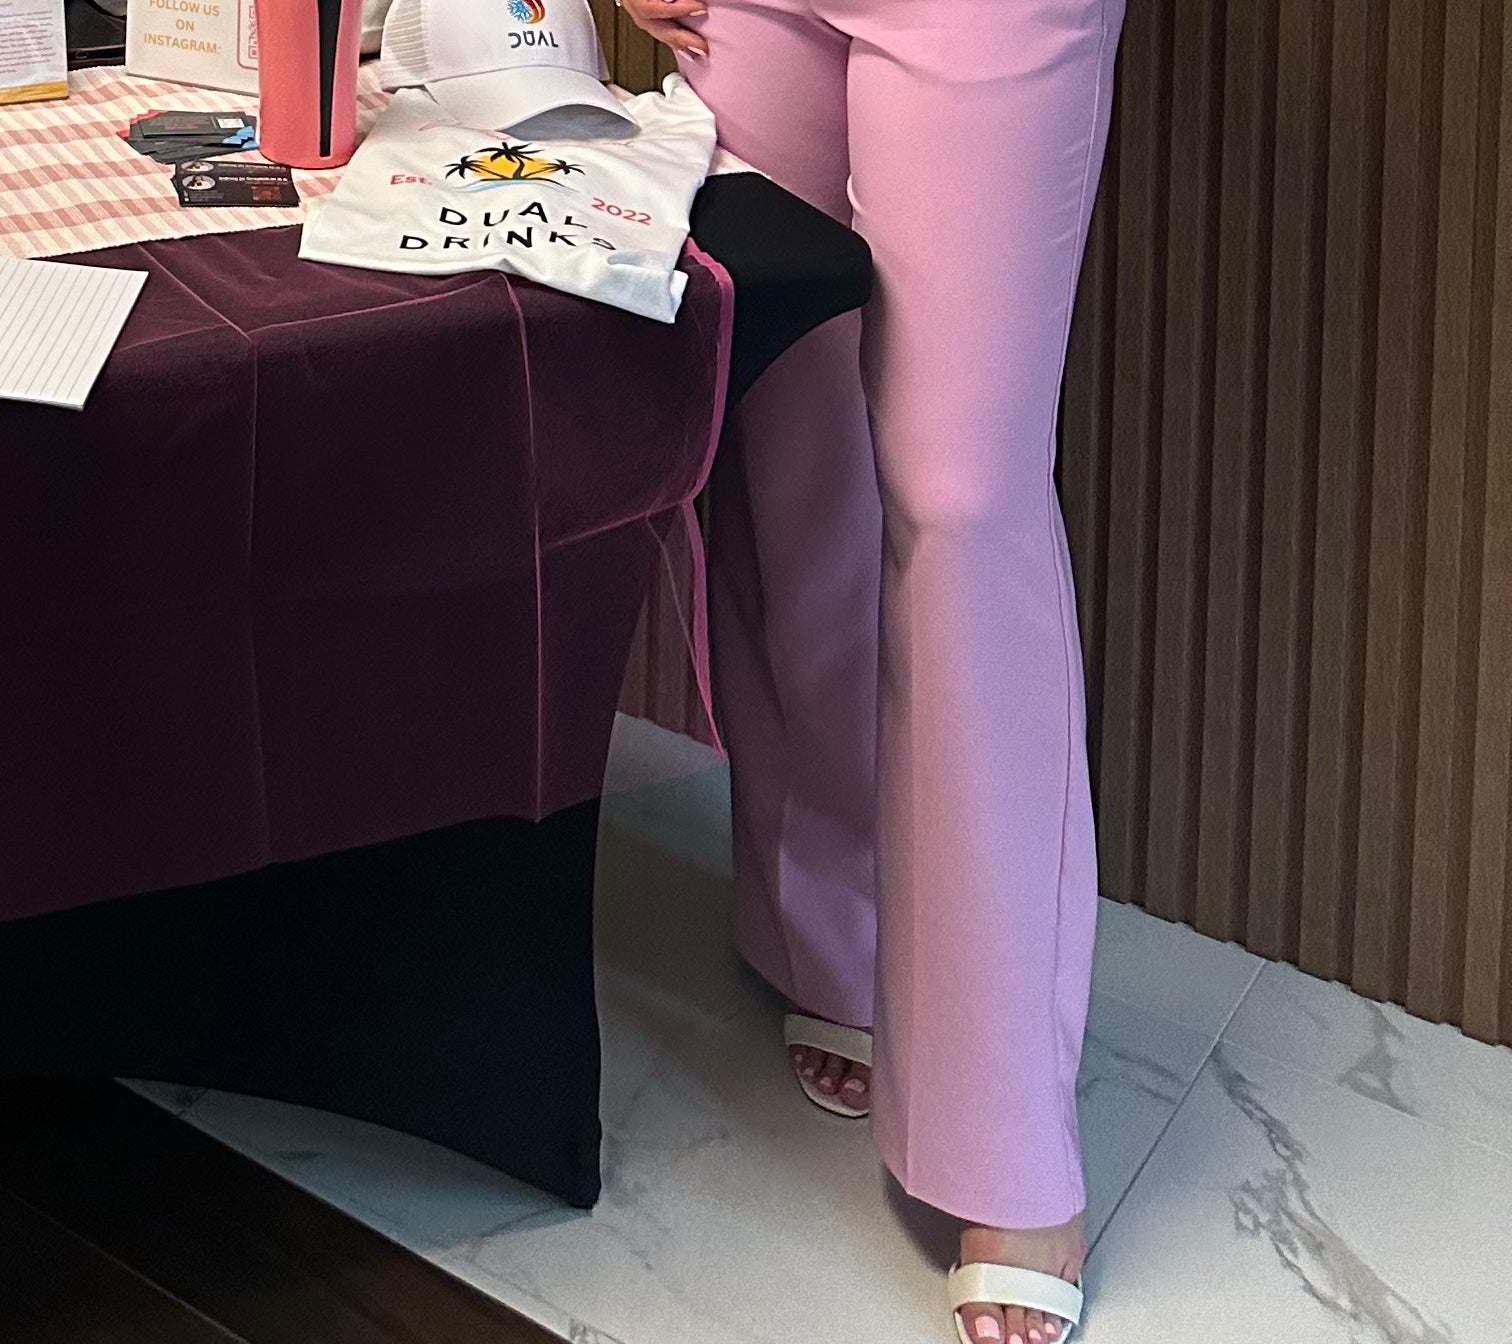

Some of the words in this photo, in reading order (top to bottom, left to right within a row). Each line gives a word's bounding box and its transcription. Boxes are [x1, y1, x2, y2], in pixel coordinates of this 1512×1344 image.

[203, 4, 221, 17] US
[175, 18, 195, 32] ON
[390, 173, 433, 186] Est.
[439, 201, 589, 229] DUAL
[591, 197, 652, 226] 2022
